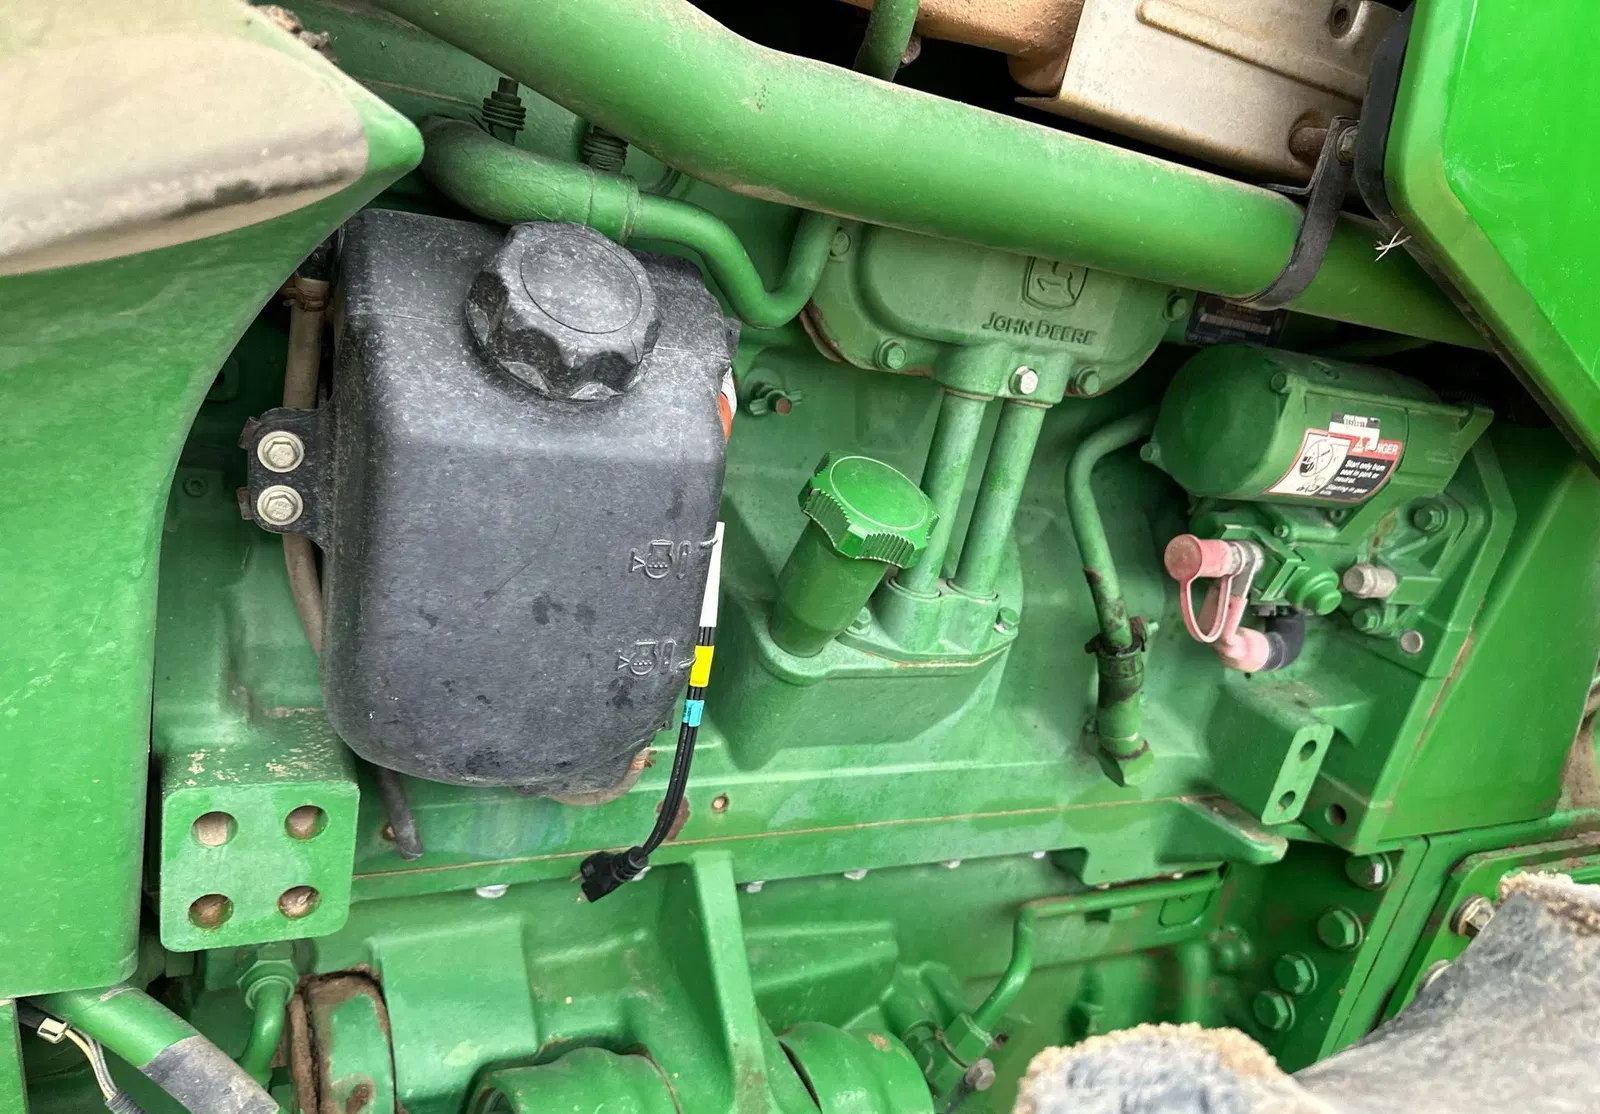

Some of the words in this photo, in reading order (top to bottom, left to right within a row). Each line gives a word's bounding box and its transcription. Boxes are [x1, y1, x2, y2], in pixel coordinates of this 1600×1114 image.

[981, 311, 1034, 335] JOHN
[1036, 319, 1098, 346] DEERE
[1345, 459, 1359, 468] Start
[1359, 462, 1372, 471] only
[1372, 463, 1386, 472] from
